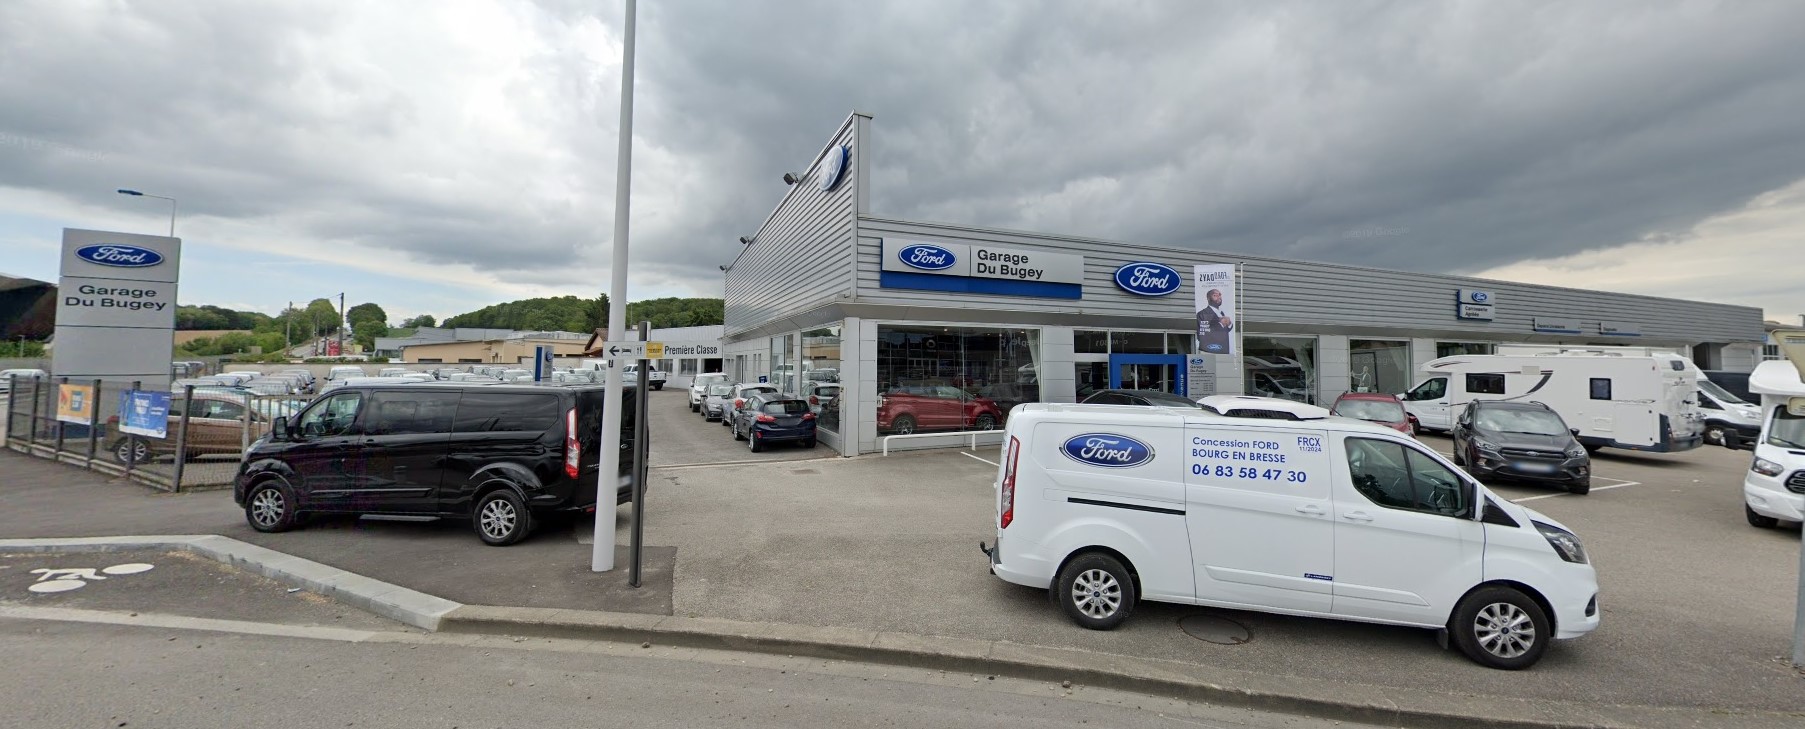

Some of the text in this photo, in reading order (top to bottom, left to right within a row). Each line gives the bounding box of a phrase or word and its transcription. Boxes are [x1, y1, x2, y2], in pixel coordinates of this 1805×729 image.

[92, 246, 146, 263] Ford
[910, 246, 946, 265] Ford
[977, 249, 1029, 264] Garage
[977, 263, 1044, 280] Du Bugey
[1129, 266, 1170, 289] Ford
[79, 285, 158, 299] Garage
[65, 297, 167, 312] Du Bugey
[664, 345, 695, 355] Première
[696, 344, 718, 355] Classe
[1192, 436, 1279, 450] Concession FORD
[1297, 436, 1320, 447] FRCX
[1080, 437, 1133, 462] Ford
[1192, 449, 1286, 463] BOURG EN BRESSE
[1192, 463, 1307, 483] 06 83 58 47 30
